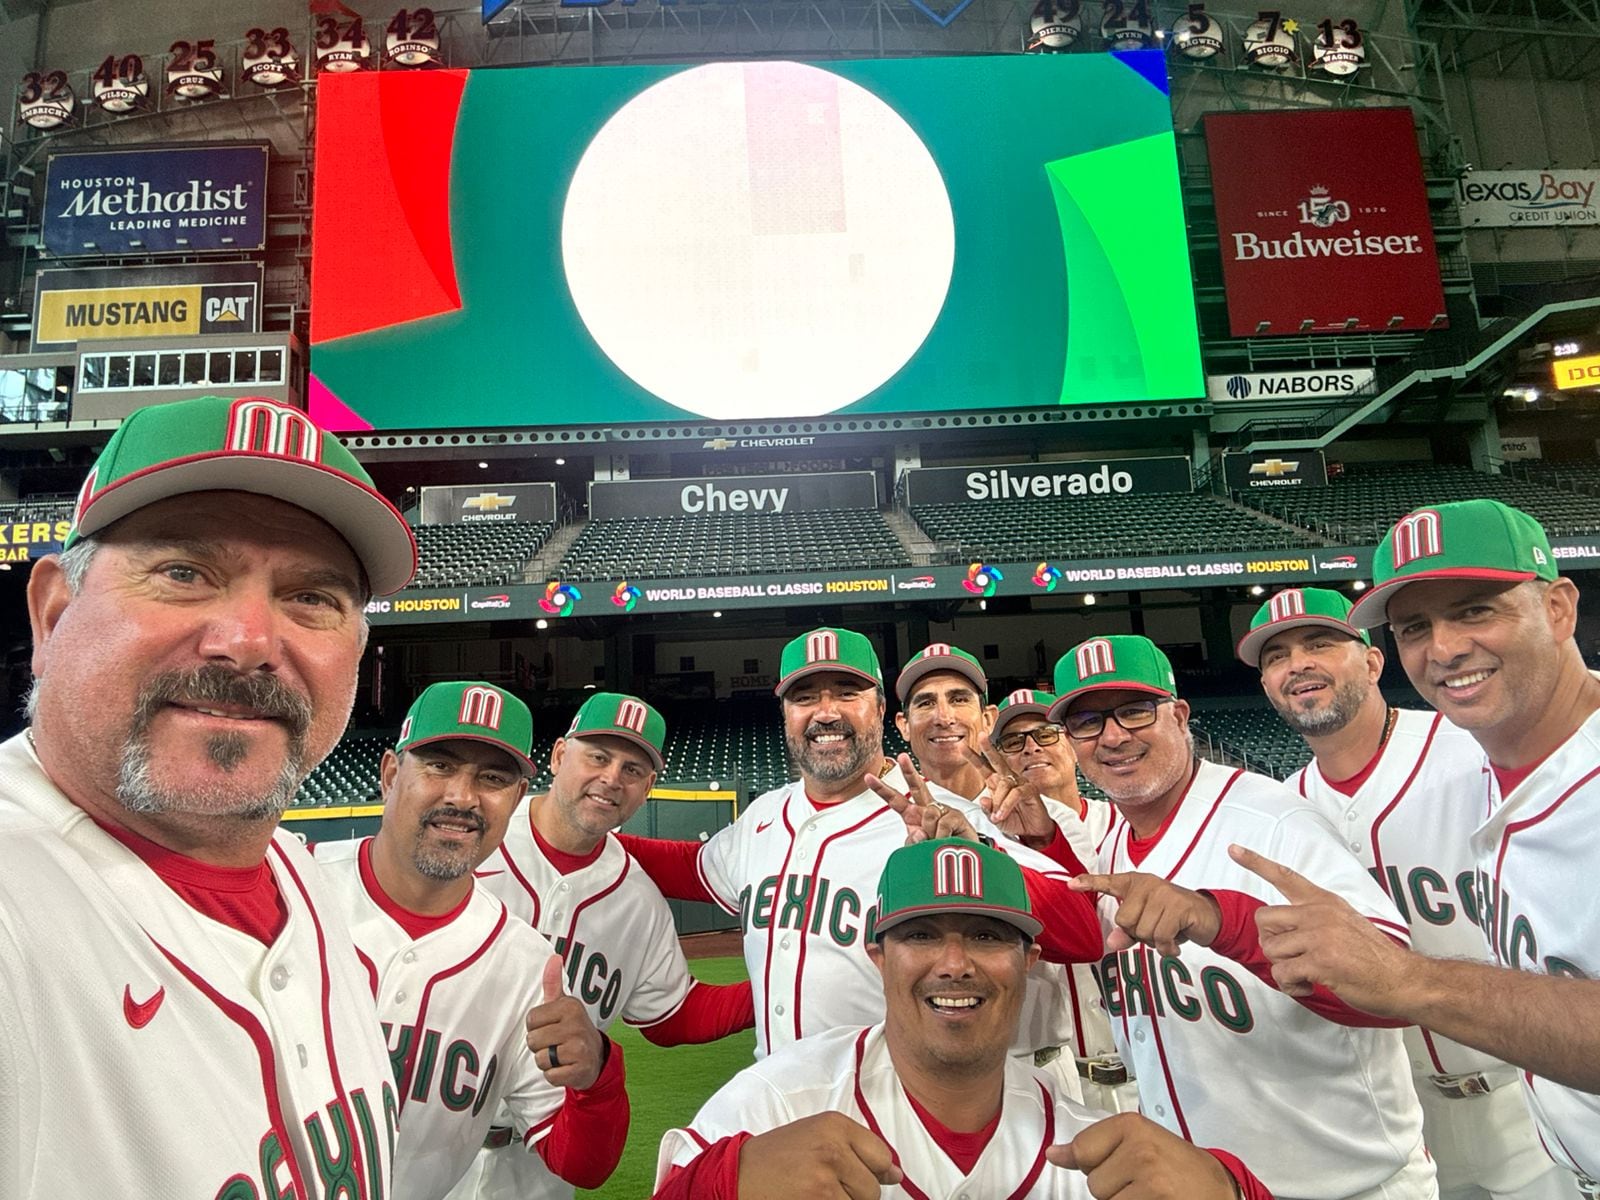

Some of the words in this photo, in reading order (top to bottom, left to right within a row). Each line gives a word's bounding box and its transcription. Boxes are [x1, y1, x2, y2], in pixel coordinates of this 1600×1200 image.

[386, 7, 438, 41] 42
[1188, 4, 1210, 35] 5
[1257, 11, 1281, 42] 7
[243, 27, 290, 60] 33
[315, 17, 368, 50] 34
[1116, 31, 1143, 39] WYNN
[1179, 38, 1221, 49] BAGWELL
[1317, 18, 1362, 49] 13
[166, 39, 216, 72] 25
[328, 52, 353, 60] RYAN
[389, 44, 433, 57] ROBINSO
[1256, 47, 1289, 55] BIGGIO
[1323, 54, 1359, 62] WAGNER
[93, 54, 144, 88] 40
[252, 64, 283, 72] SCOTT
[20, 70, 68, 104] 32
[180, 77, 204, 85] CRUZ
[100, 91, 136, 100] WILSON
[61, 176, 136, 190] HOUSTON
[1536, 173, 1596, 208] Bay
[58, 180, 248, 218] Methodist
[110, 218, 172, 231] LEADING
[178, 216, 248, 228] MEDICINE
[1256, 210, 1289, 218] SINCE
[1508, 211, 1551, 222] CREDIT
[1554, 210, 1597, 221] UNION
[1231, 229, 1420, 260] Budweiser
[65, 299, 187, 328] MUSTANG
[205, 297, 249, 323] CAT
[1259, 375, 1354, 395] NABORS
[740, 437, 816, 448] CHEVROLET
[966, 465, 1133, 500] Silverado
[1250, 478, 1303, 487] CHEVROLET
[681, 483, 789, 514] Chevy
[462, 513, 517, 521] CHEVROLET
[1066, 568, 1116, 582] WORLD
[1117, 565, 1186, 579] BASEBALL
[1187, 562, 1243, 576] CLASSIC
[1246, 559, 1309, 573] HOUSTON
[646, 588, 696, 601] WORLD
[697, 584, 766, 598] BASEBALL
[766, 583, 823, 596] CLASSIC
[826, 580, 888, 593] HOUSTON
[394, 598, 460, 612] HOUSTON
[740, 874, 878, 947] MEXIC
[541, 933, 622, 1020] ICO
[1091, 948, 1255, 1034] EXICO
